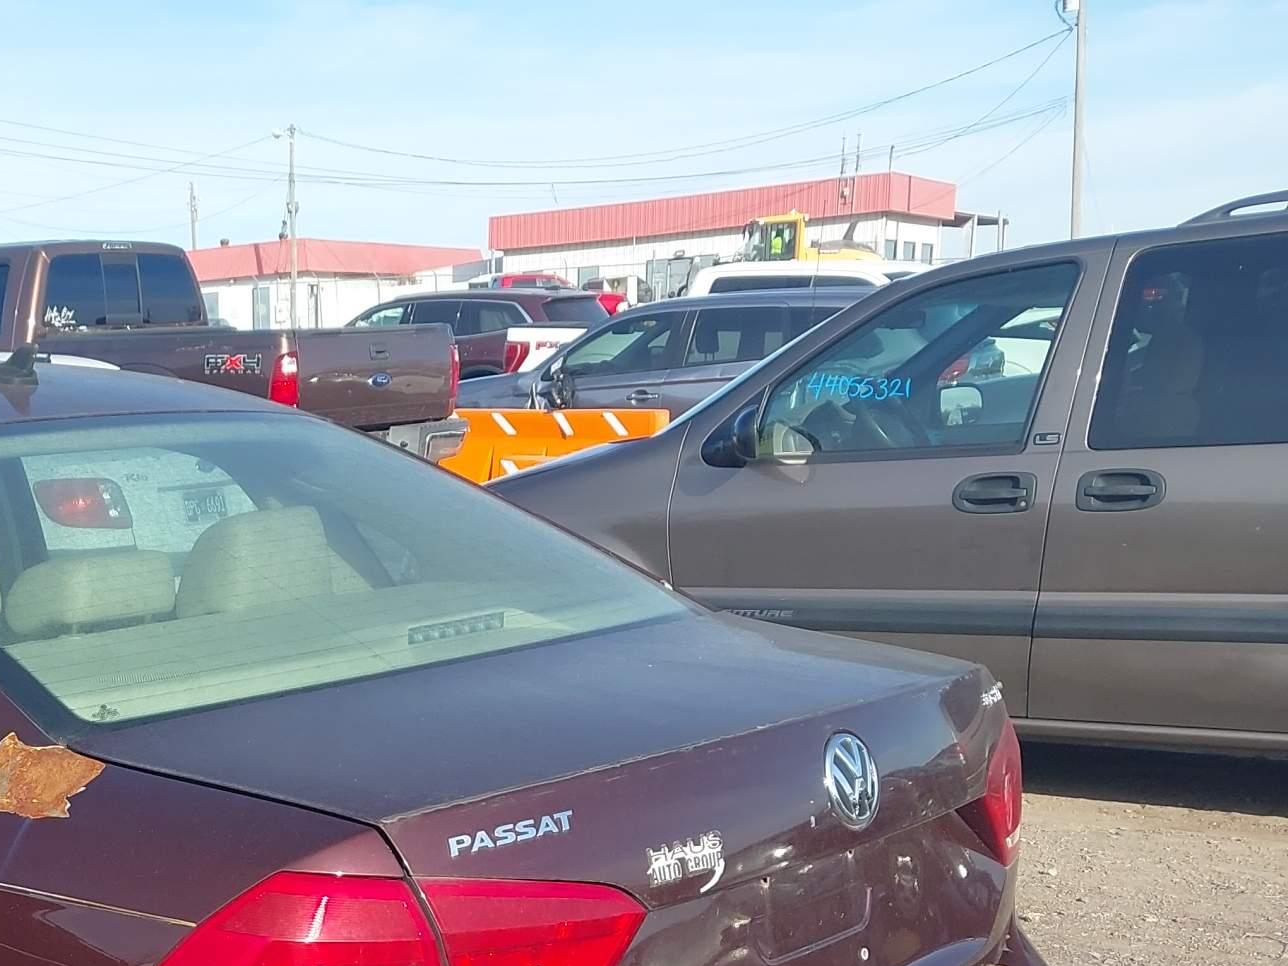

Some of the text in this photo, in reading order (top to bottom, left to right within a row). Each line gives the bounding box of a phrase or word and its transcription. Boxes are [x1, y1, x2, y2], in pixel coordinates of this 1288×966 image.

[204, 353, 262, 370] FX4
[807, 371, 912, 400] 44055321
[448, 809, 574, 858] PASSAT
[650, 860, 682, 884] AUTO
